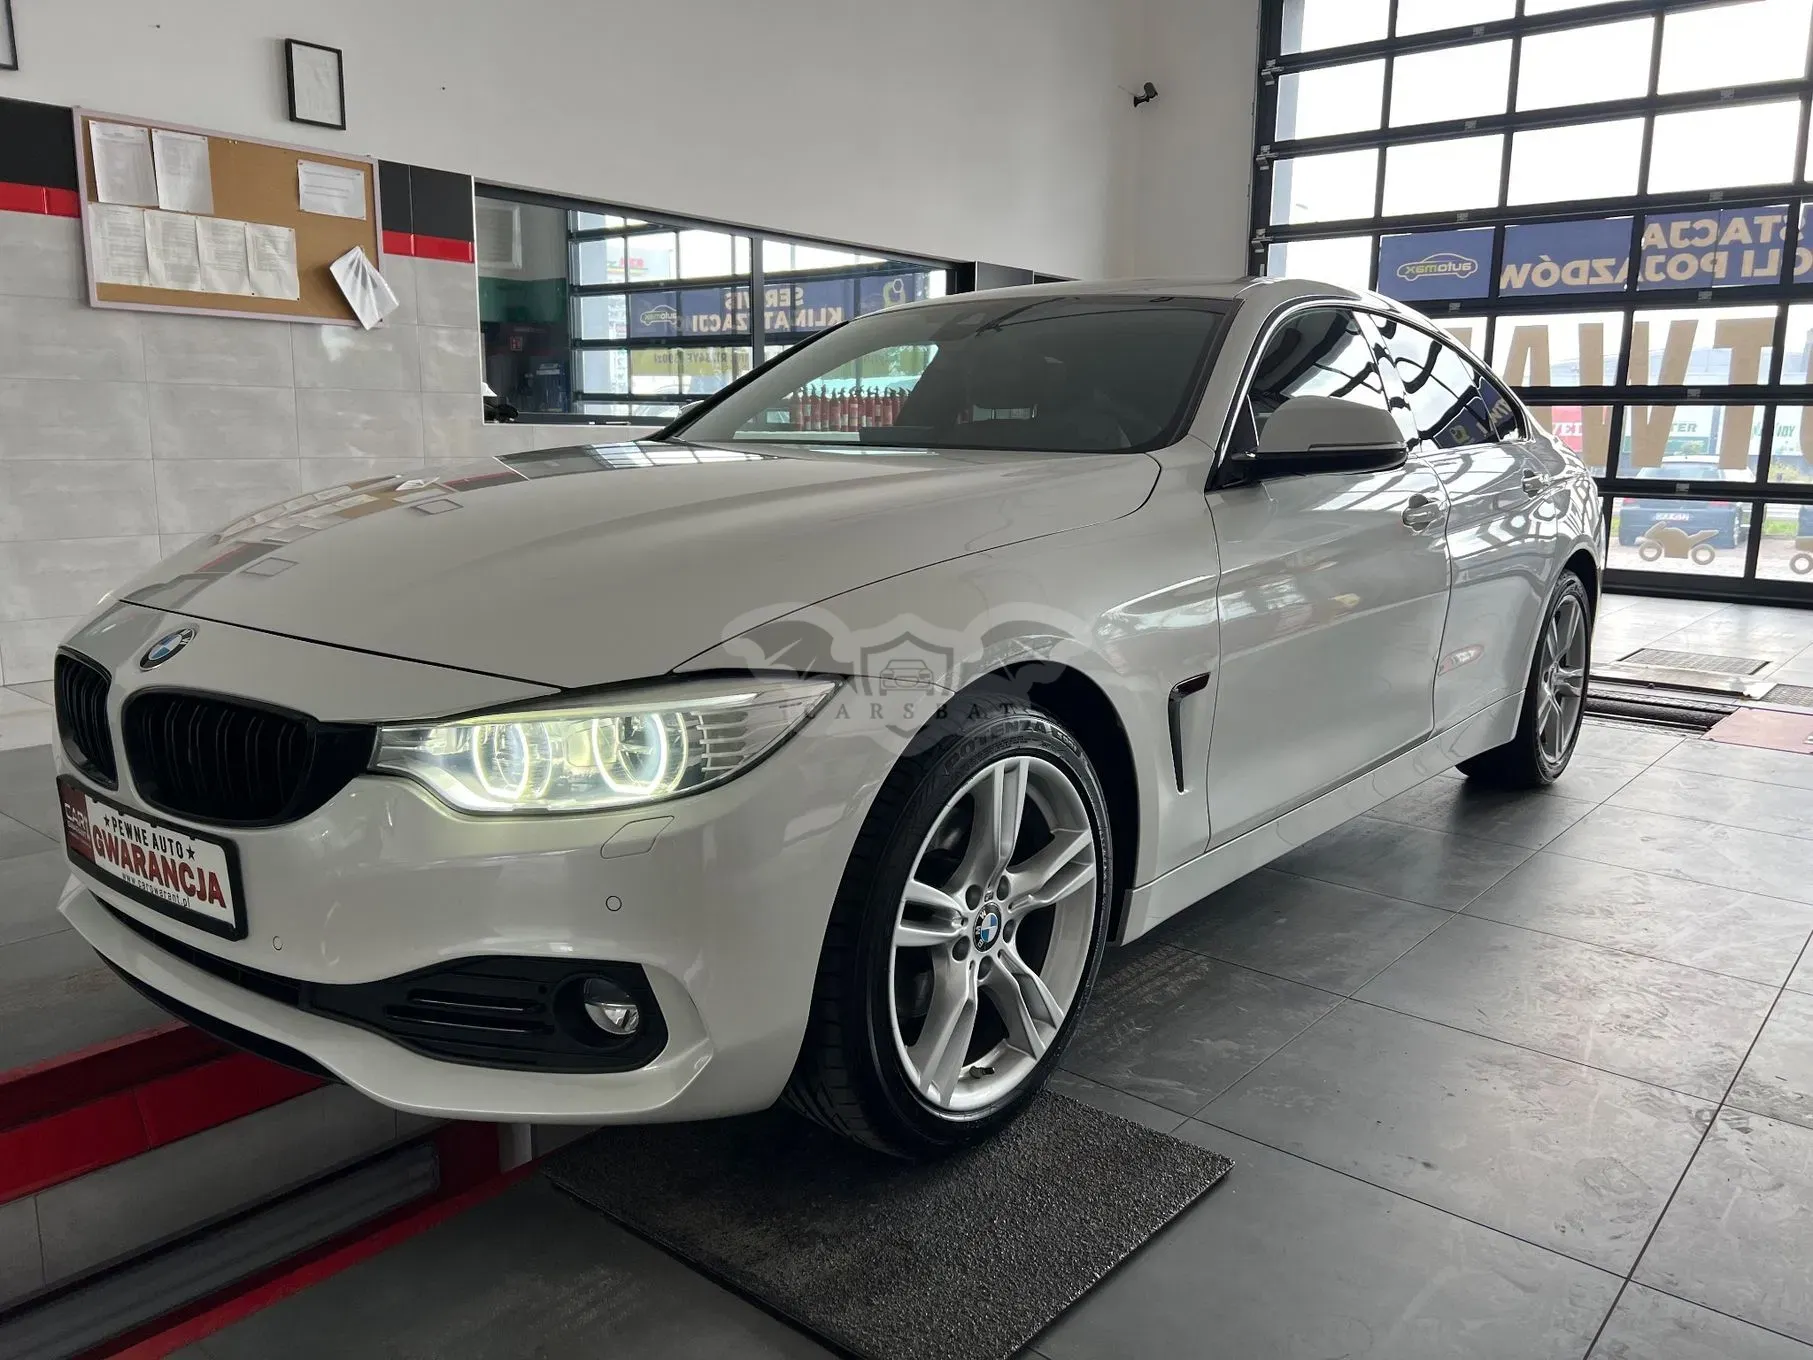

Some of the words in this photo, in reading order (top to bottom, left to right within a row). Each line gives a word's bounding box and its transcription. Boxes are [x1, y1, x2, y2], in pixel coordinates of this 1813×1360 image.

[92, 824, 227, 909] GWARANCJA
[111, 816, 149, 847] PEWNE
[152, 832, 184, 859] AUTO
